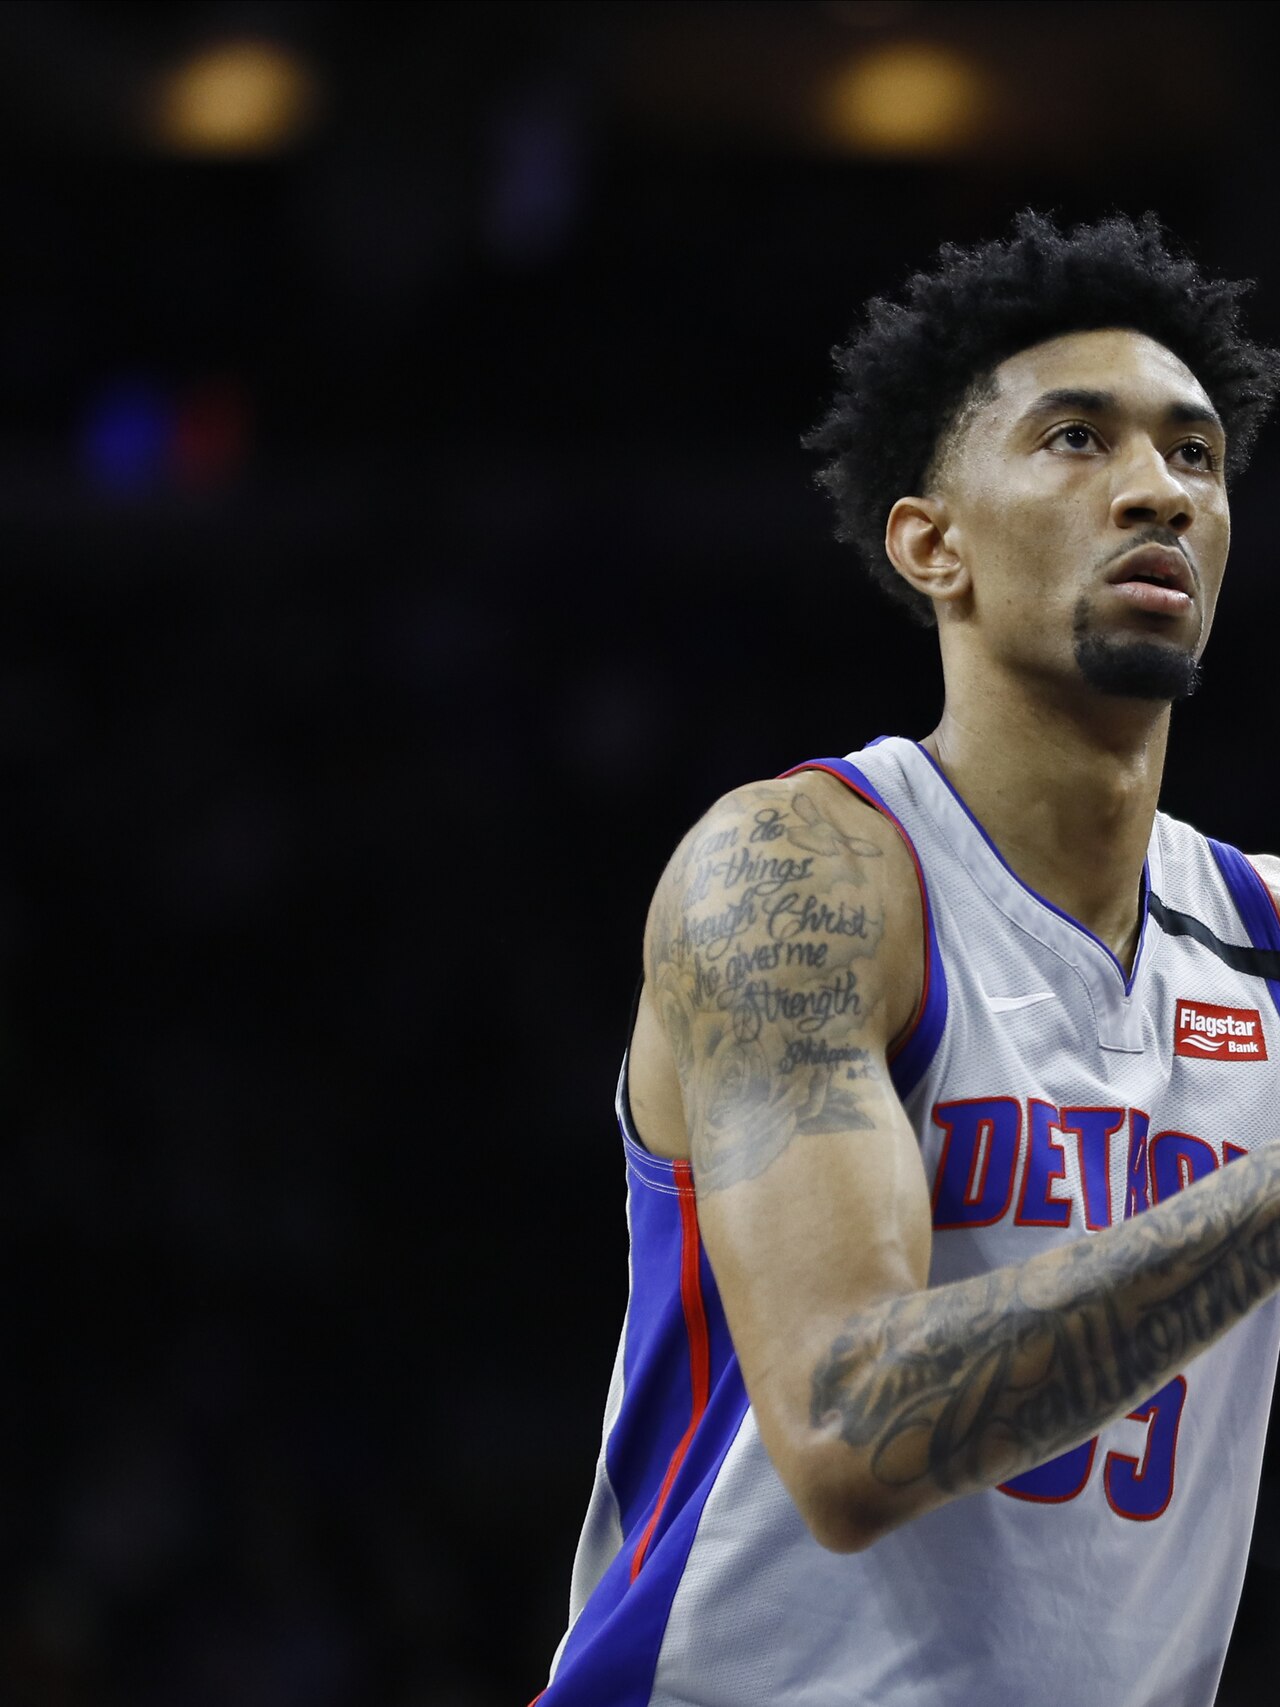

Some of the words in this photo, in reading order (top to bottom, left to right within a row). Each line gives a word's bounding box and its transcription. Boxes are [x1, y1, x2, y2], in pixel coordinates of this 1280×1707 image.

[713, 847, 814, 896] things
[762, 893, 878, 939] Christ
[786, 942, 829, 969] me
[1180, 1008, 1255, 1037] Flagstar
[1228, 1041, 1260, 1053] Bank
[932, 1095, 1249, 1232] DETRO
